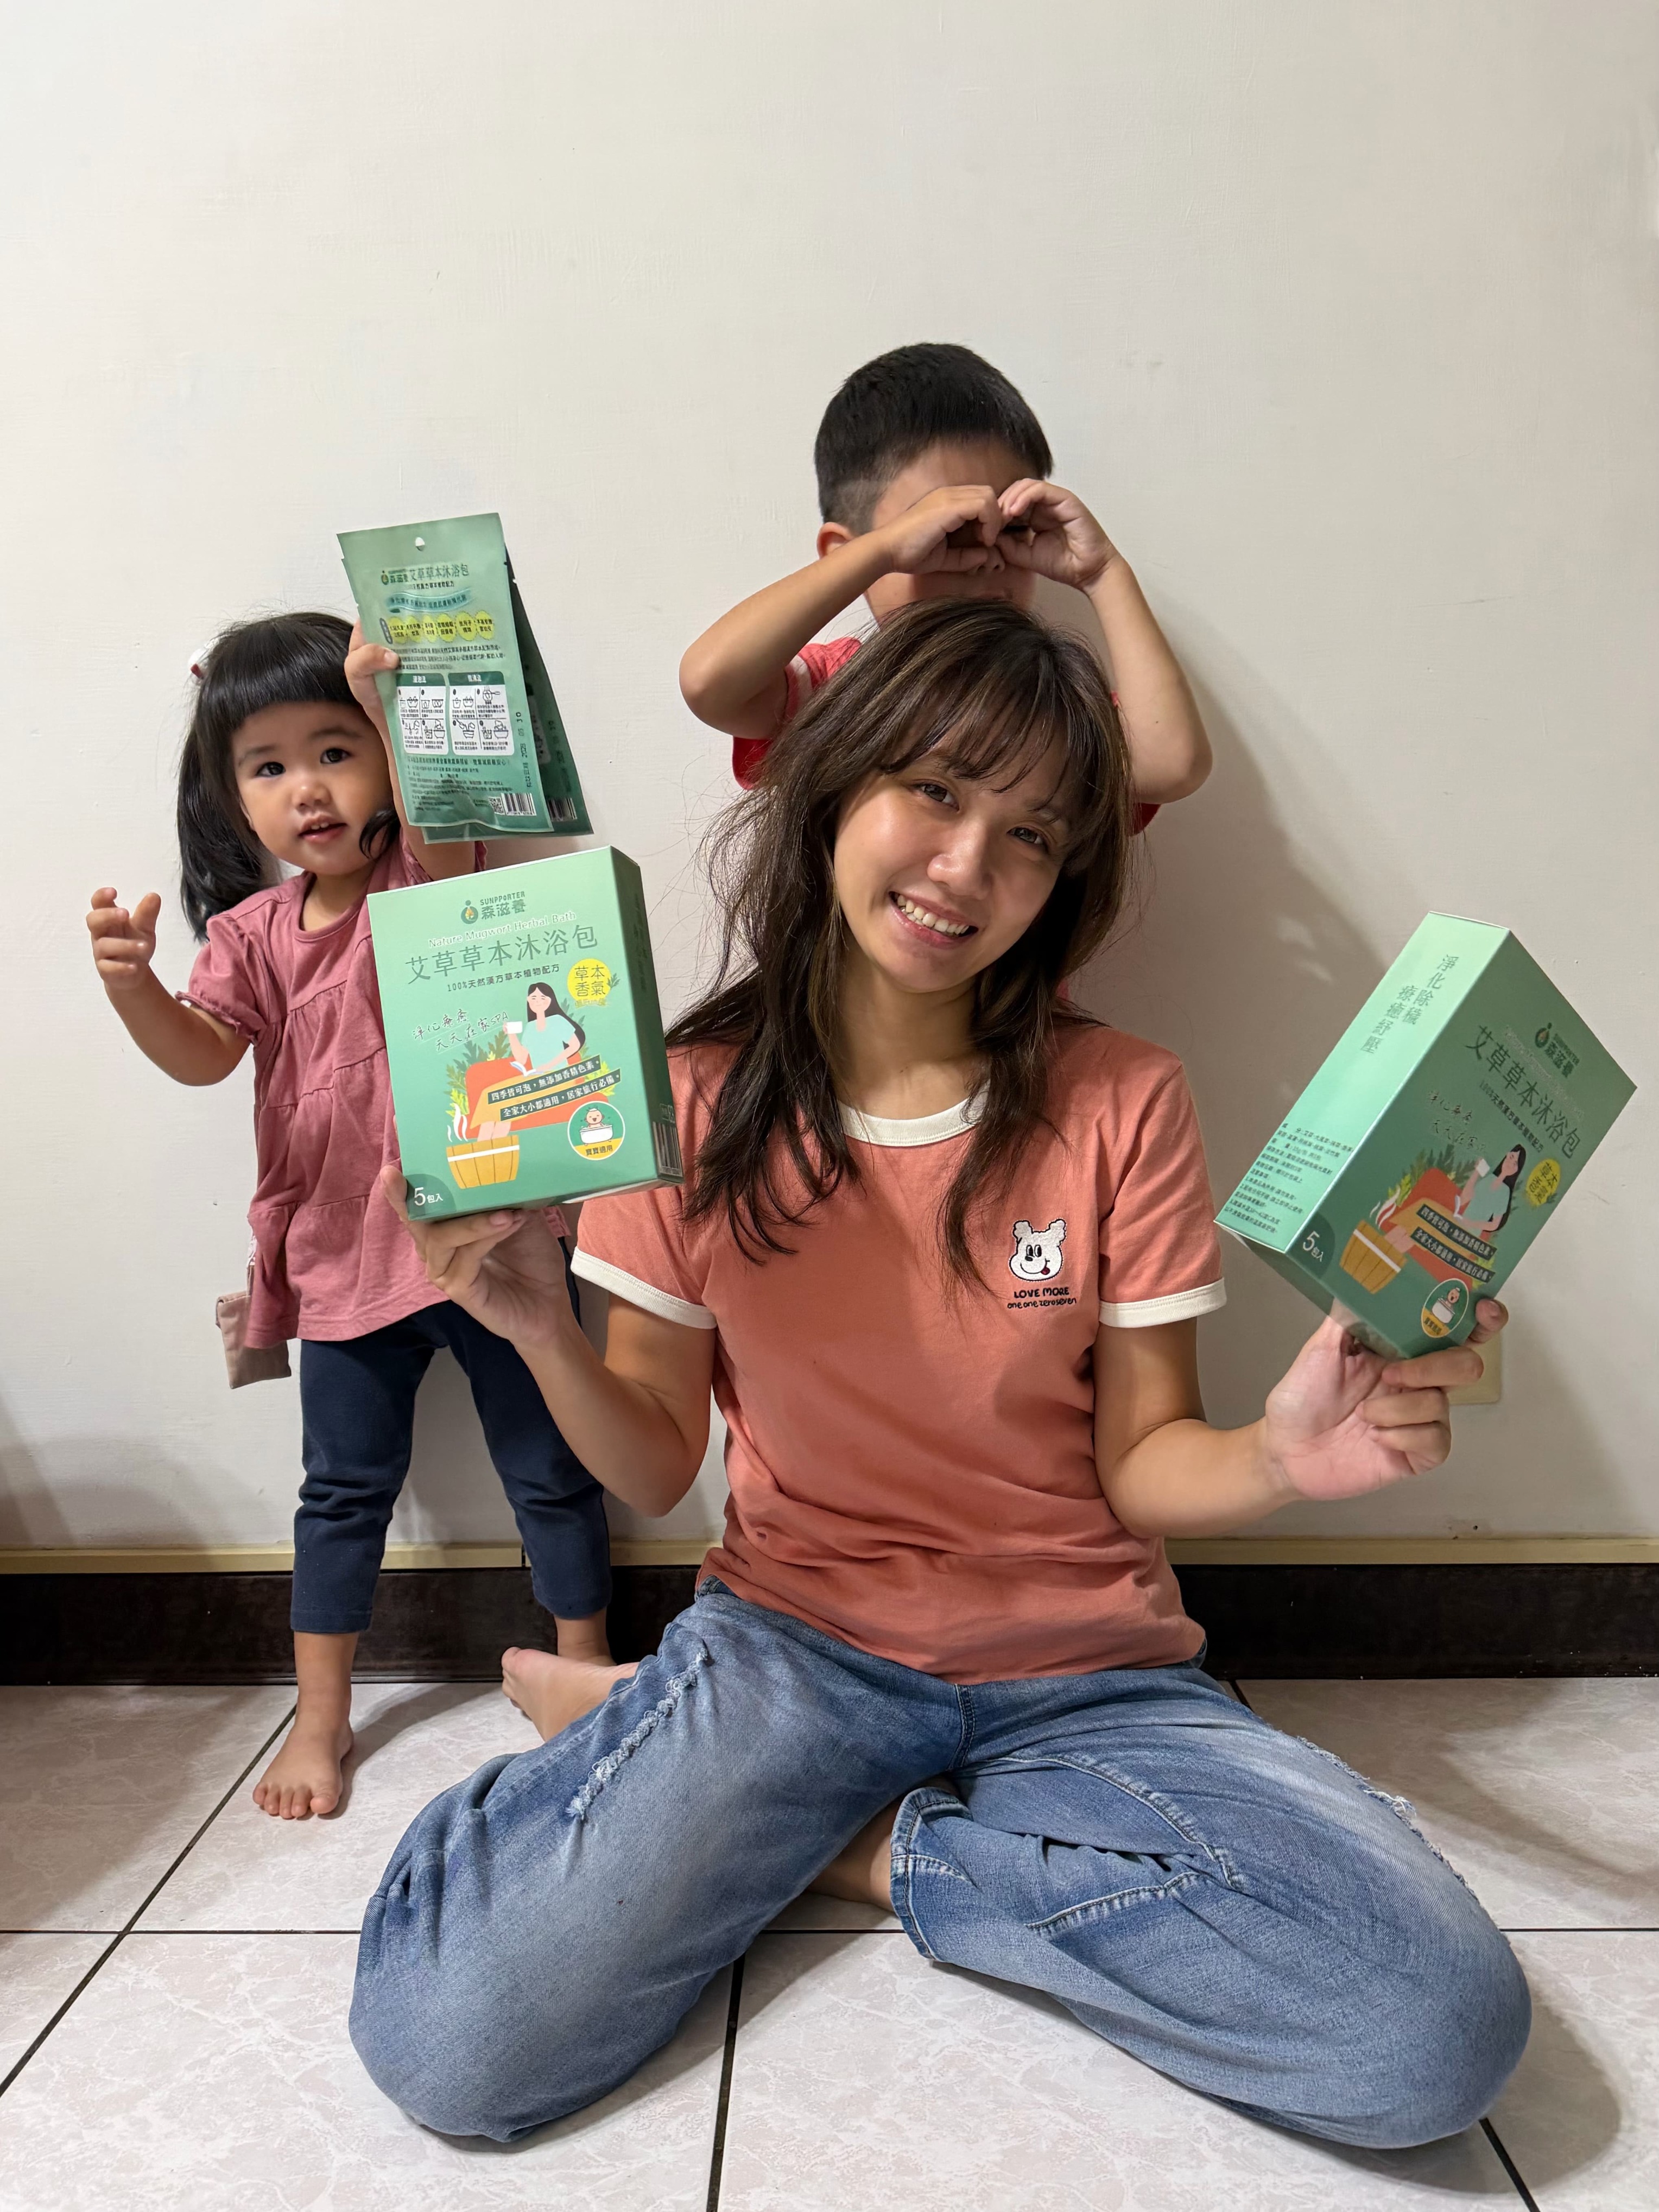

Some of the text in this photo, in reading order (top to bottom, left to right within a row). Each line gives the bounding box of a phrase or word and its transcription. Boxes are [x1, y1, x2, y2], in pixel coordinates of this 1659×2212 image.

[409, 564, 469, 582] 艾草草本沐浴包
[480, 892, 525, 905] SUNPPORTER
[482, 899, 525, 920] 森滋養
[428, 911, 577, 948] Nature Mugwort Herbal Bath
[405, 925, 597, 984] 艾草草本沐浴包
[447, 964, 559, 992] 100%天然漢方草本植物配方
[574, 965, 605, 981] 草本
[575, 981, 605, 996] 香氣
[1403, 954, 1459, 1025] 淨化除穢
[1360, 985, 1418, 1053] 療癒紓壓
[1465, 1025, 1580, 1159] 艾草草本沐浴包
[1014, 1287, 1069, 1298] LOVE MORE
